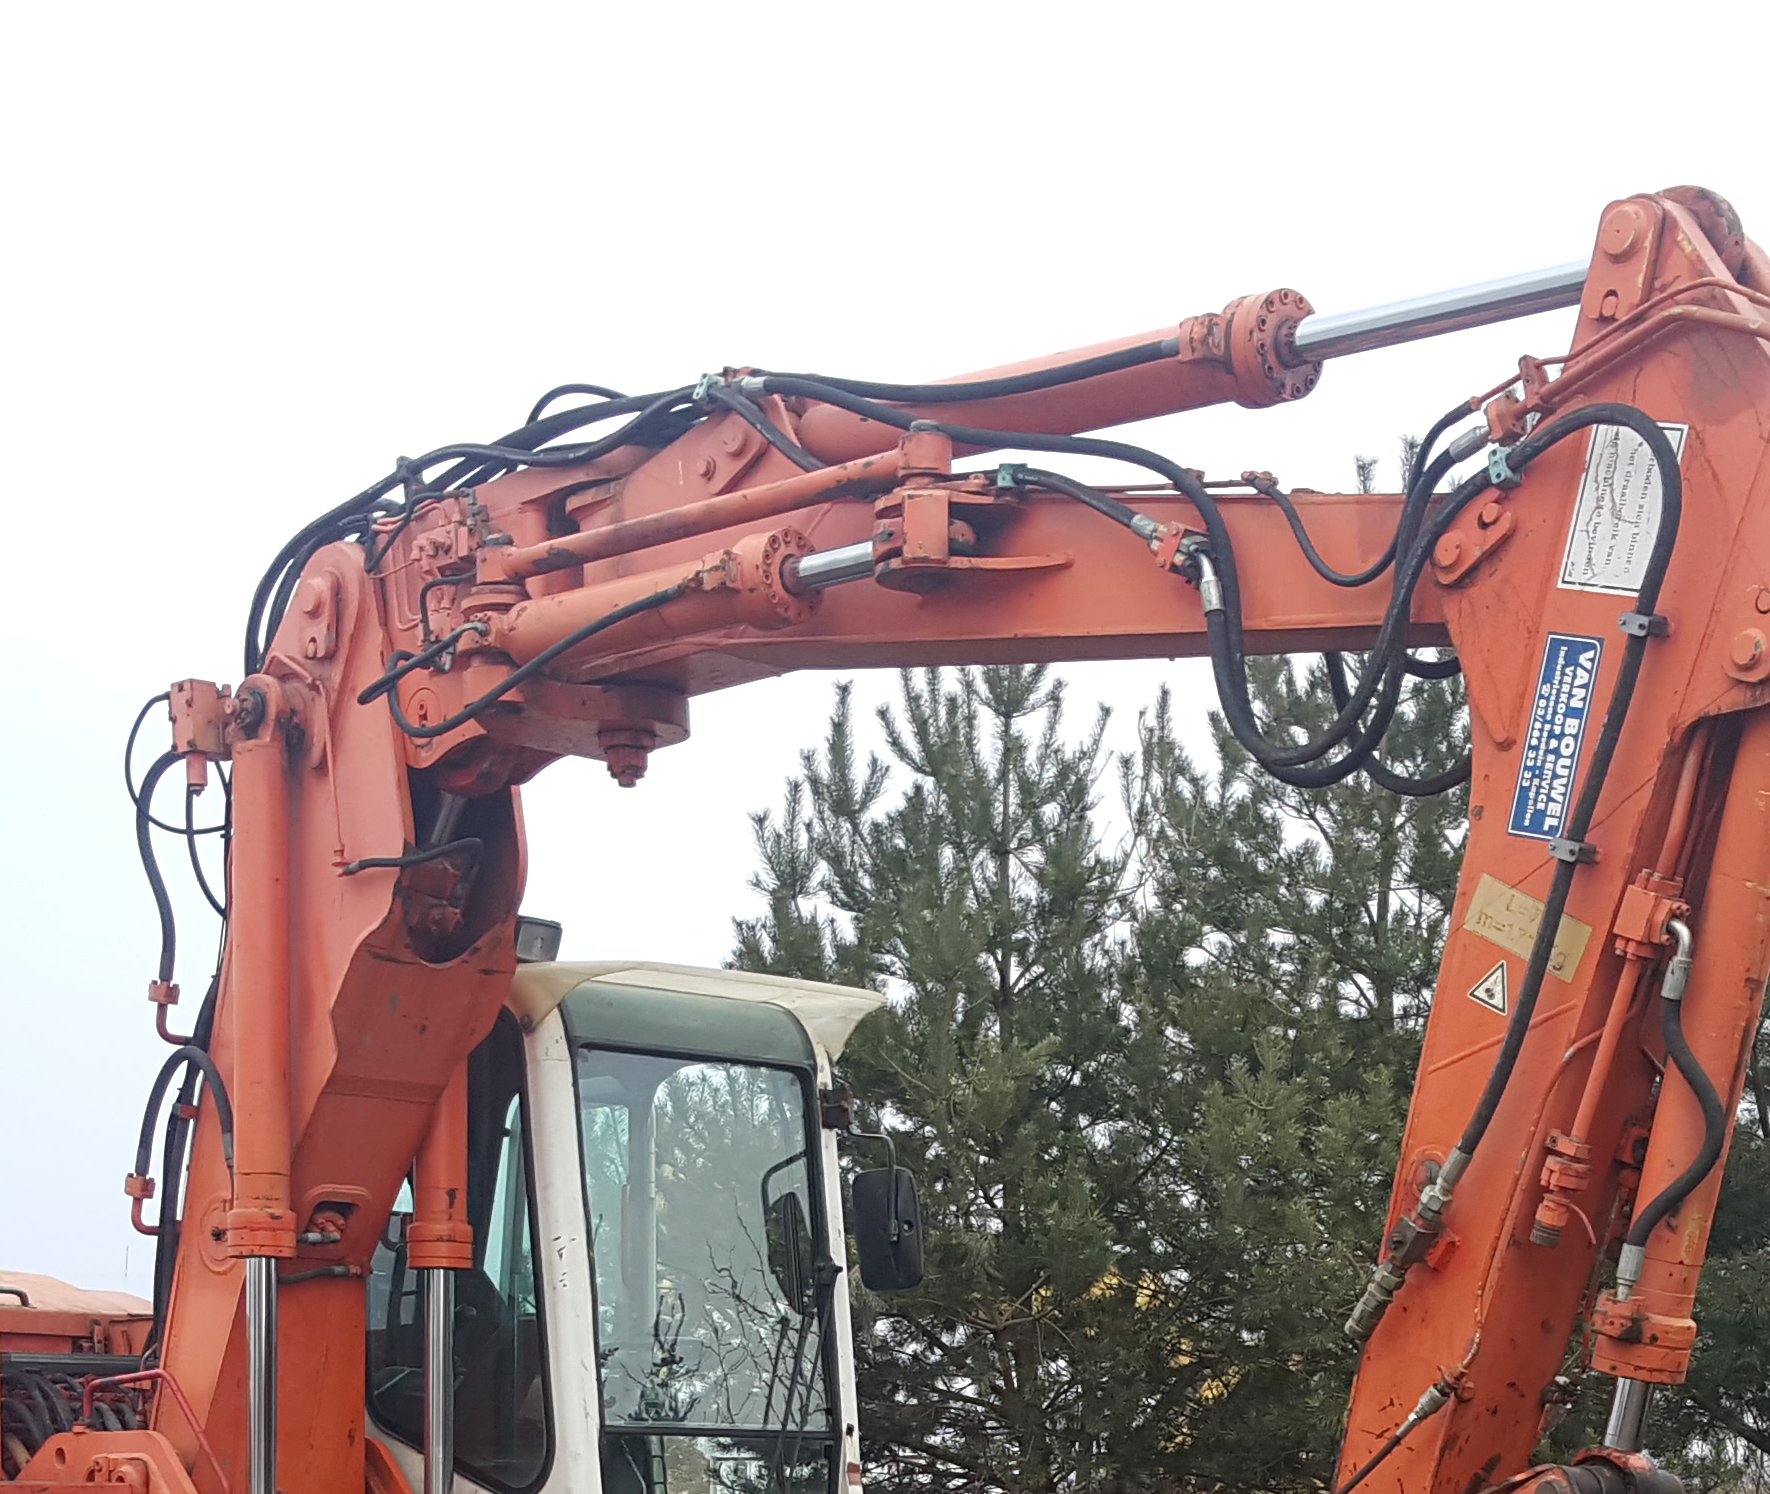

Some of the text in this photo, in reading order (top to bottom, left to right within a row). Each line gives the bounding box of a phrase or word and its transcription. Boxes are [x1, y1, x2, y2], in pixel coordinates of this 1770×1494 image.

[1640, 452, 1656, 500] rboden
[1605, 545, 1615, 566] van
[1537, 666, 1574, 810] VERKOOP & SERVICE
[1543, 650, 1595, 831] VAN BOUWEL
